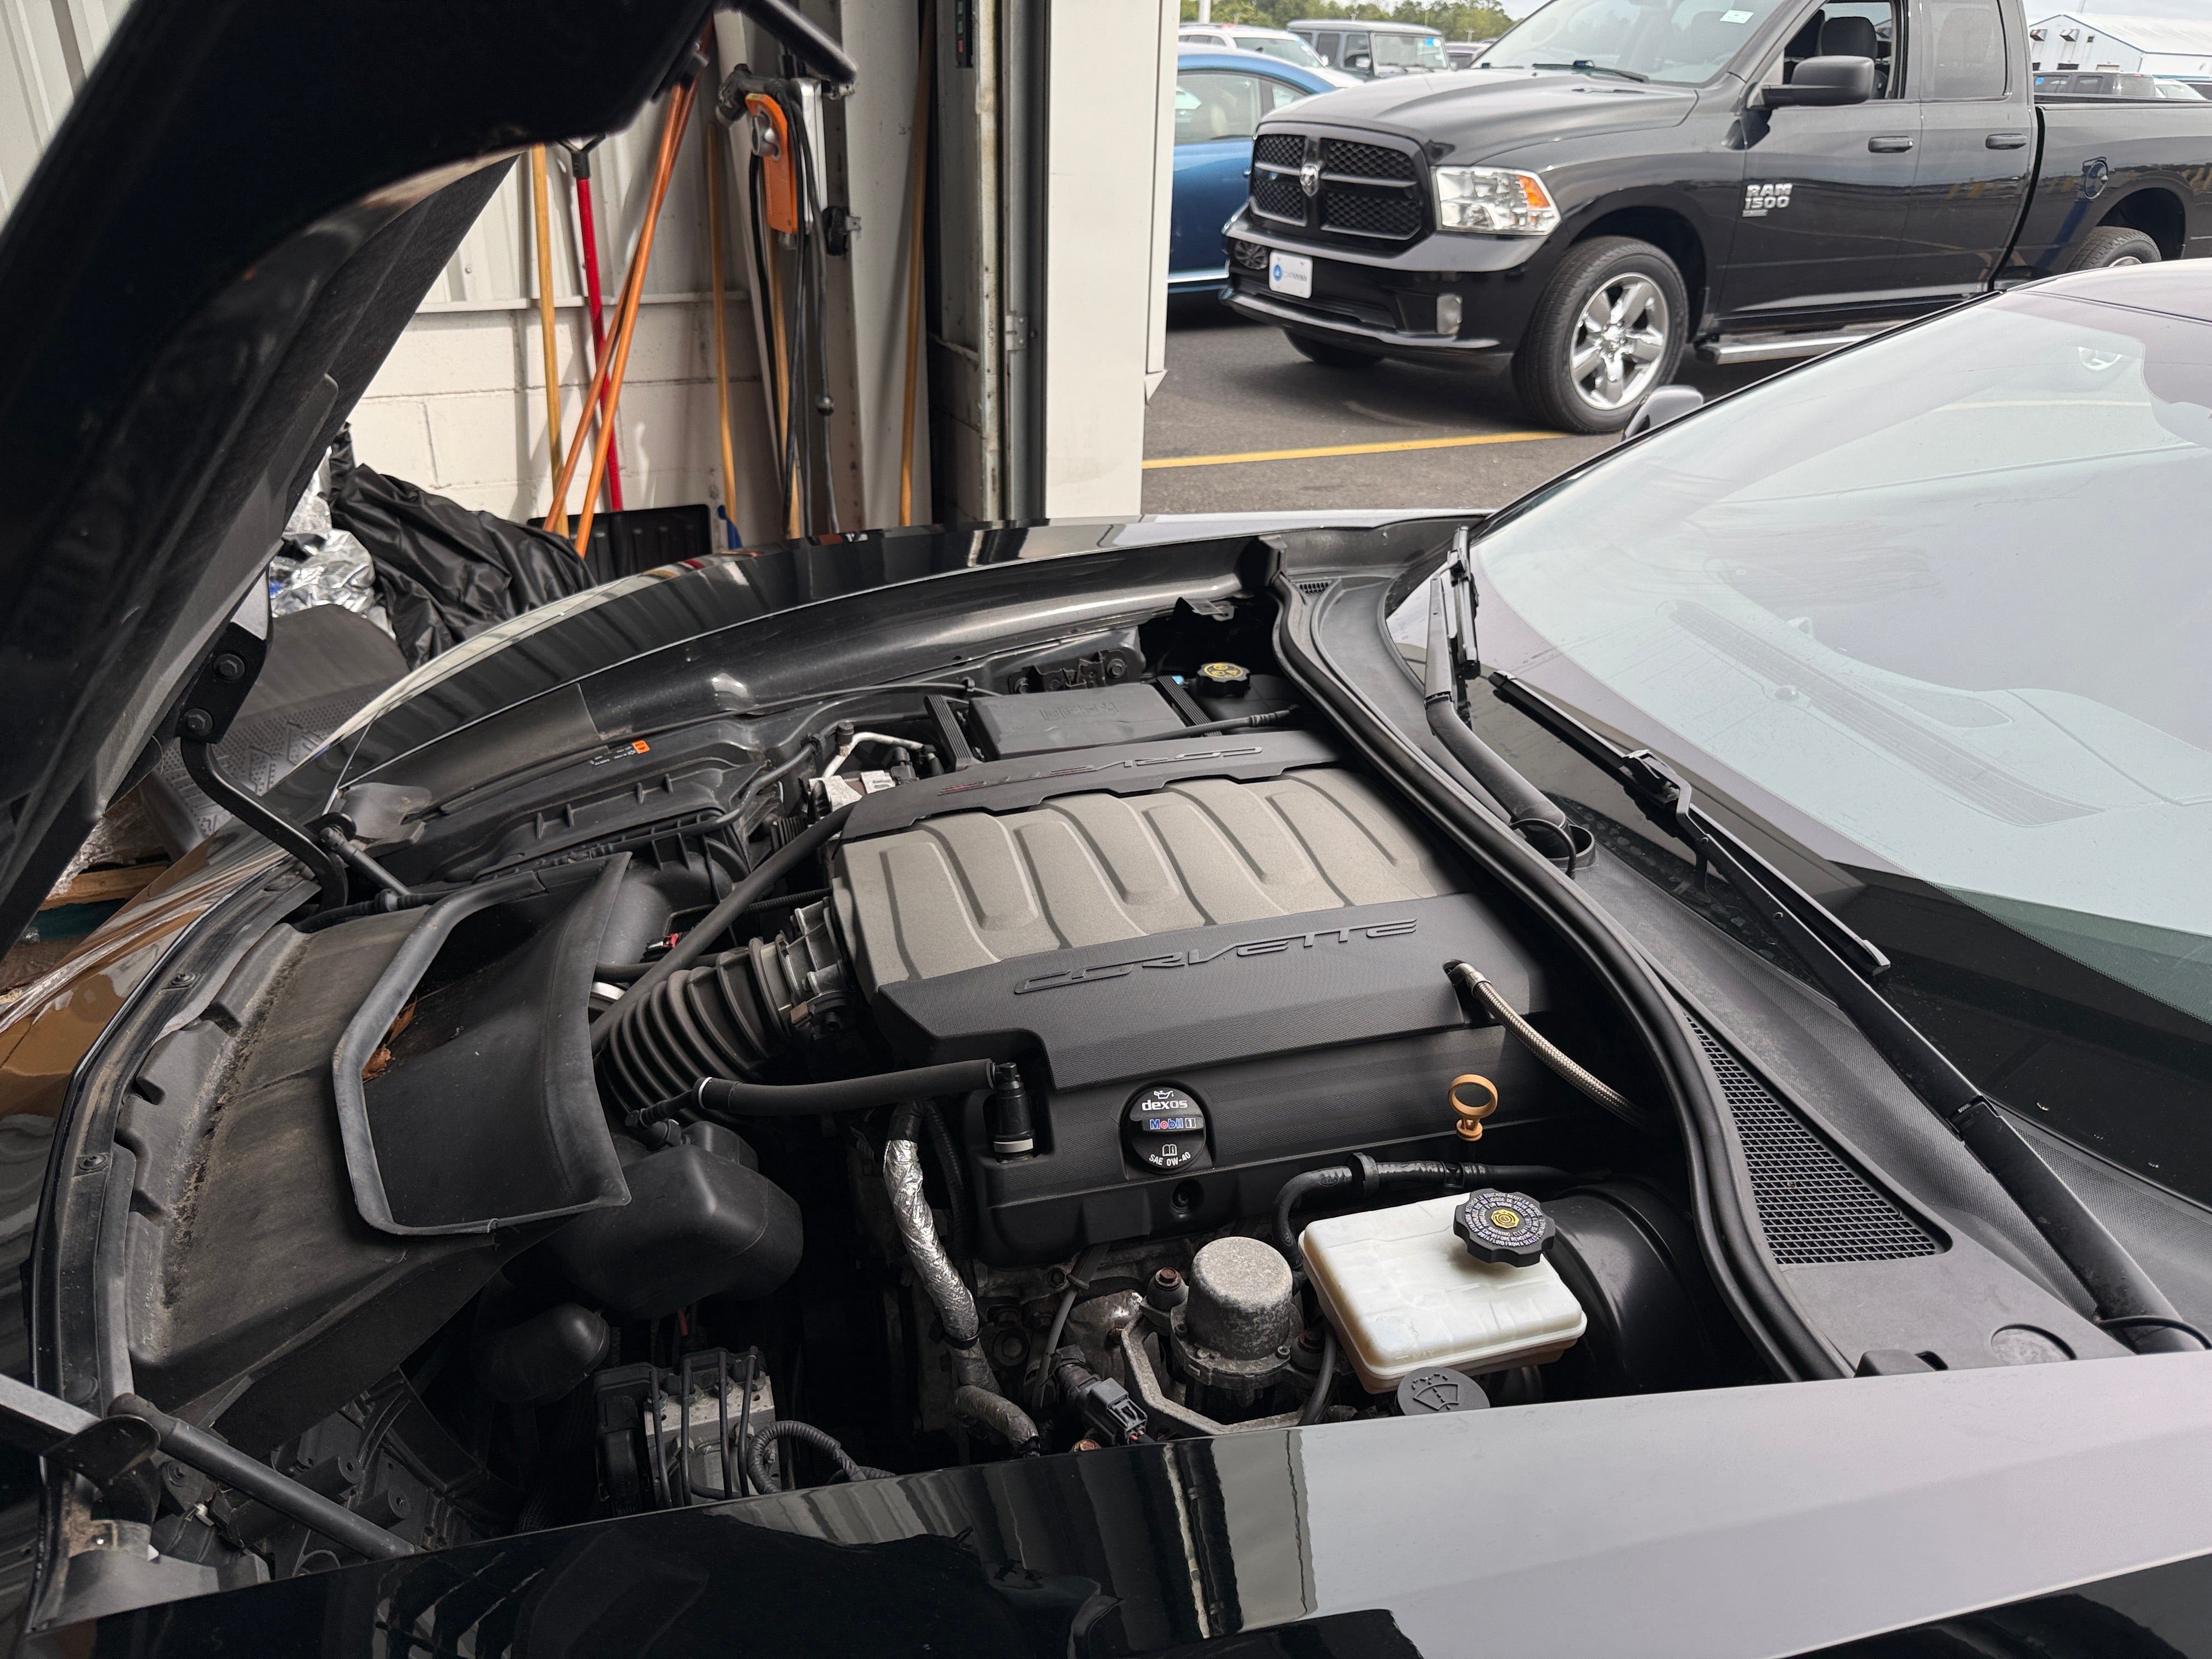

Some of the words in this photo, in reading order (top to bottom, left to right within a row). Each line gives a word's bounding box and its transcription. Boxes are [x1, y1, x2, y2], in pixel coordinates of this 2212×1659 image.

[1746, 183, 1793, 197] RAM
[1745, 195, 1790, 210] 1500
[1014, 918, 1417, 994] CORVETTE
[1142, 1099, 1188, 1111] dexos
[1149, 1118, 1183, 1130] Mobil
[1149, 1154, 1164, 1165] SAE
[1166, 1152, 1191, 1166] 0W-40
[1490, 1233, 1510, 1241] BEFORE
[1513, 1228, 1528, 1236] CLEAN
